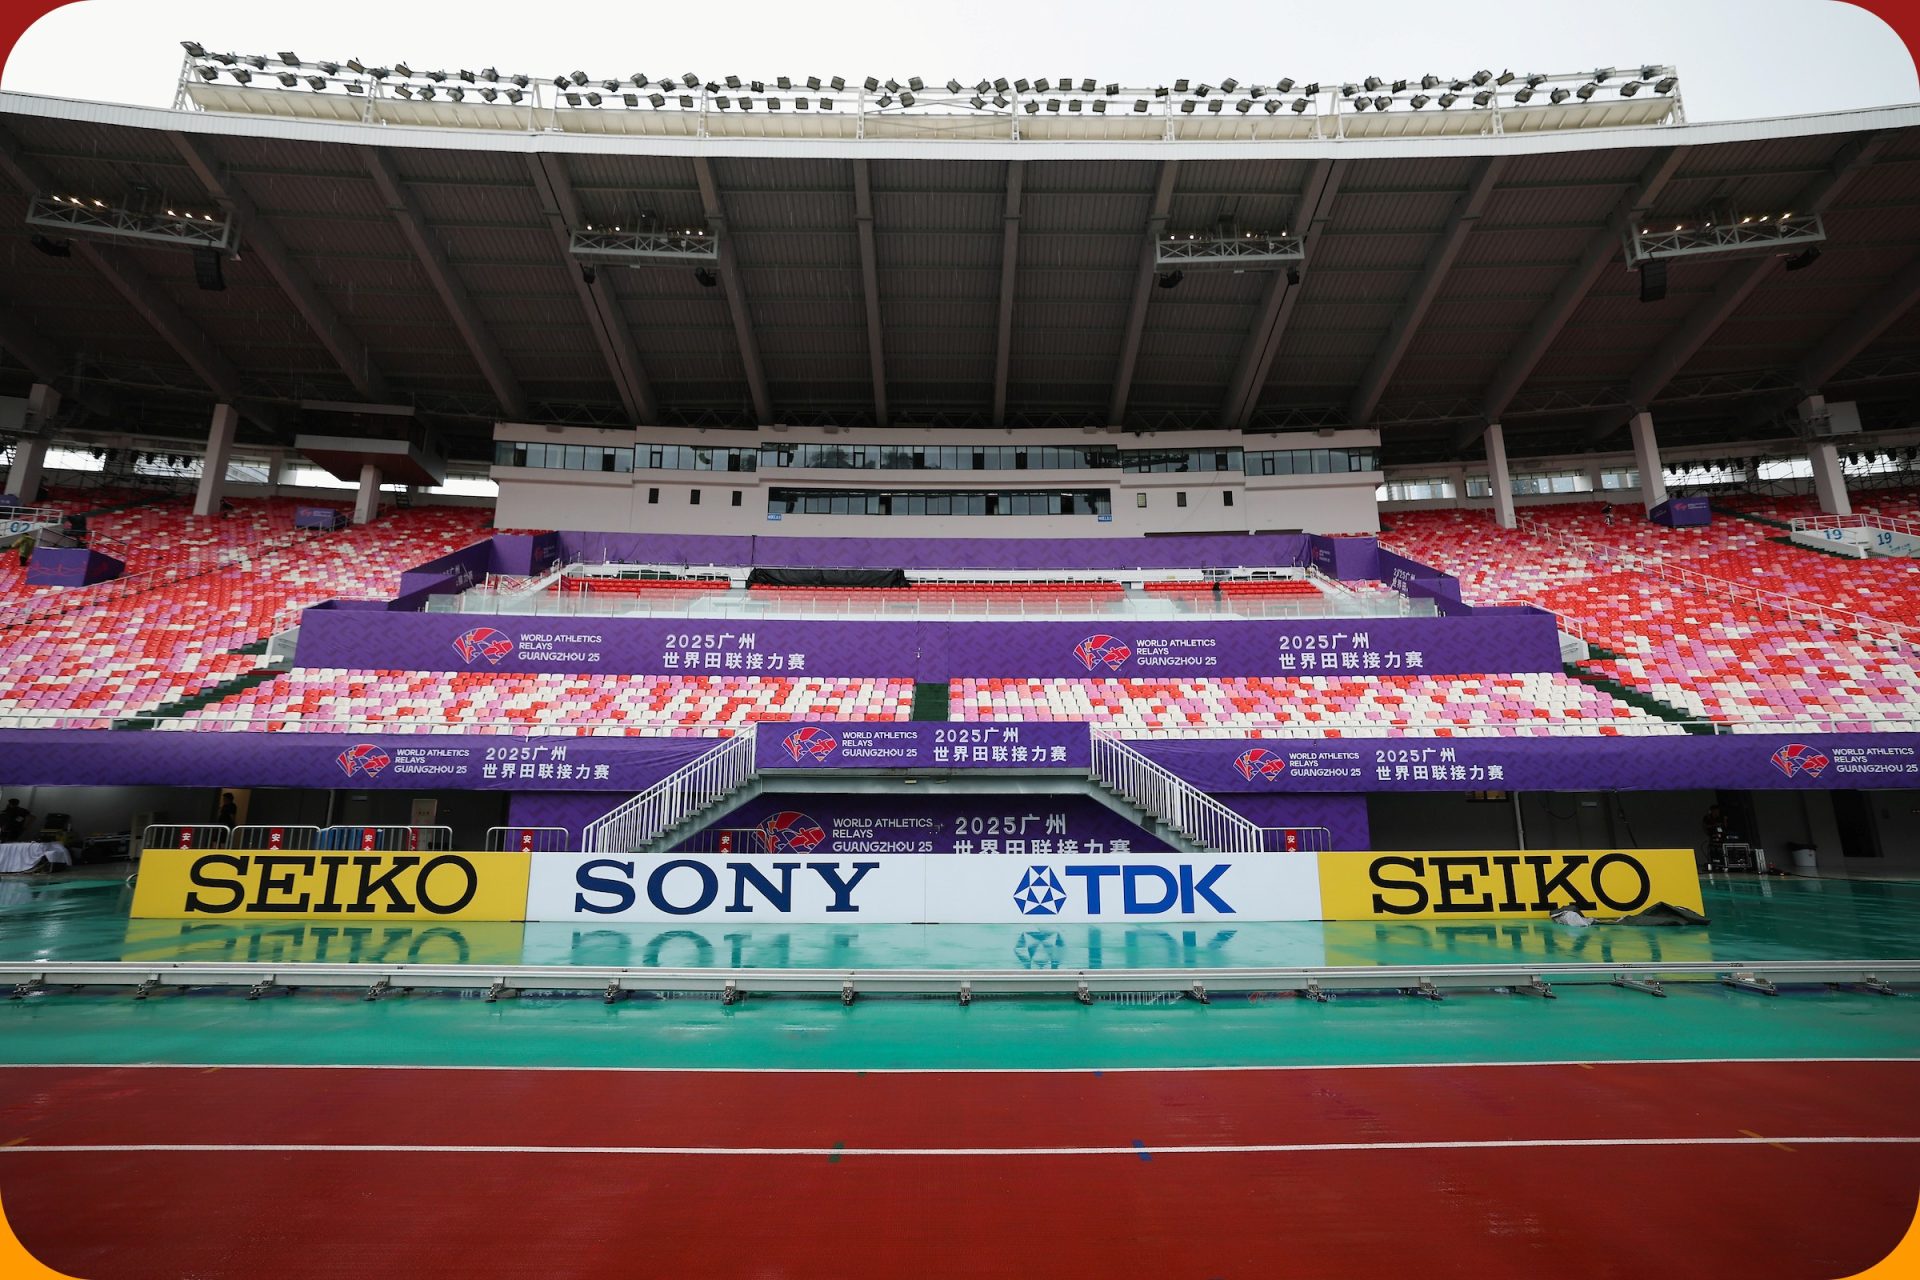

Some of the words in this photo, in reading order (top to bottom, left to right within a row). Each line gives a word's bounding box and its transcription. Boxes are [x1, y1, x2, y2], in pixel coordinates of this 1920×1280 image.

[10, 522, 30, 533] 02
[1824, 528, 1842, 540] 19
[1876, 532, 1892, 546] 19
[521, 634, 551, 643] WORLD
[554, 634, 602, 644] ATHLETICS
[666, 634, 755, 649] 2025广州
[1136, 639, 1167, 647] WORLD
[1170, 639, 1216, 647] ATHLETICS
[1280, 633, 1369, 649] 2025广州
[519, 642, 552, 650] RELAYS
[518, 652, 584, 661] GUANGZHOU
[587, 653, 601, 662] 25
[663, 652, 804, 669] 世界田联接力赛
[1137, 656, 1202, 666] GUANGZHOU
[1205, 656, 1217, 665] 25
[1279, 652, 1423, 669] 世界田联接力赛
[936, 728, 1018, 742] 2025广州
[427, 749, 470, 757] ATHLETICS
[486, 746, 566, 760] 2025广州
[842, 748, 903, 757] GUANGZHOU
[906, 748, 918, 757] 25
[934, 746, 1066, 761] 世界田联接力赛
[1376, 748, 1454, 762] 2025广州
[1832, 748, 1865, 756] WORLD
[1867, 747, 1915, 756] ATHLETICS
[395, 756, 426, 764] RELAYS
[394, 765, 454, 774] GUANGZHOU
[456, 766, 467, 774] 25
[483, 763, 609, 779] 世界田联接力赛
[1291, 768, 1347, 777] GUANGZHOU
[1350, 768, 1362, 777] 25
[1376, 765, 1503, 780] 世界田联接力赛
[1836, 764, 1903, 774] GUANGZHOU
[1906, 764, 1918, 774] 25
[833, 818, 871, 827] WORLD
[874, 818, 933, 827] ATHLETICS
[956, 815, 1065, 834] 2025广州
[833, 829, 874, 838] RELAYS
[833, 842, 914, 852] GUANGZHOU
[917, 842, 933, 852] 25
[185, 855, 477, 914] SEIKO
[575, 860, 879, 914] SONY
[1066, 865, 1236, 914] TDK
[1371, 854, 1650, 913] SEIKO
